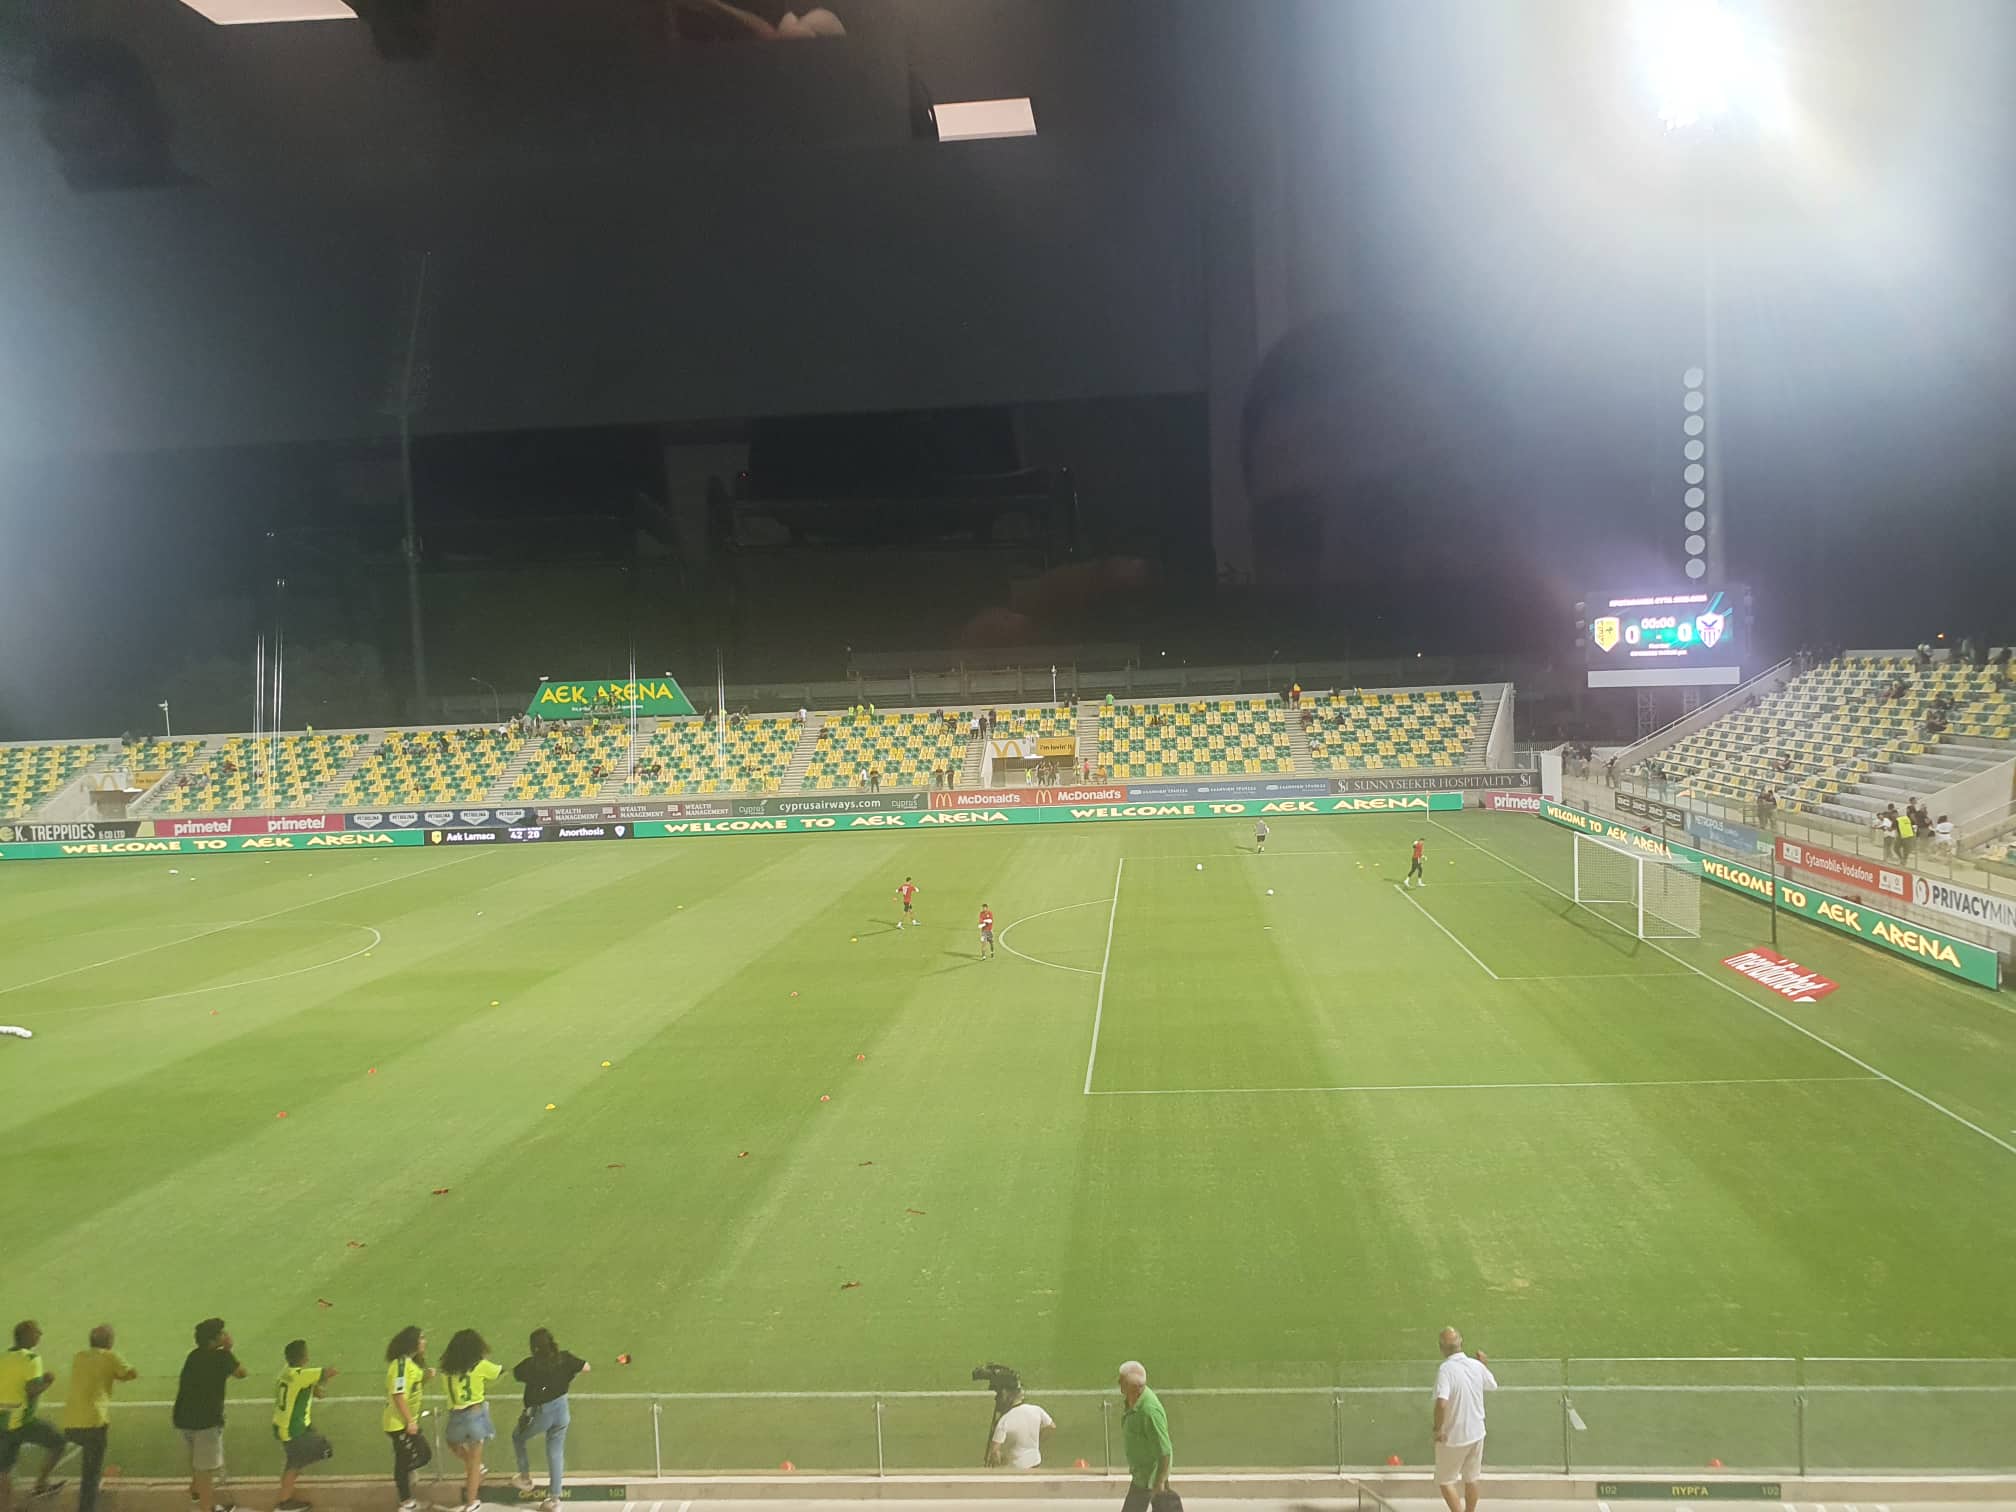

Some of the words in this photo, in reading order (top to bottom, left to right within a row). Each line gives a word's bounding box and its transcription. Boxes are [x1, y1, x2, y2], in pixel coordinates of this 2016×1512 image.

[1625, 626, 1640, 644] 0
[1677, 623, 1693, 642] 0
[541, 686, 588, 704] AEK
[594, 682, 673, 703] ARENA
[1354, 778, 1436, 791] SUNNYSEEKER
[1440, 776, 1514, 788] HOSPITALITY
[957, 794, 1020, 805] McDonald's
[1057, 790, 1121, 801] McDonald's
[620, 810, 664, 818] MANAGEMENT
[685, 803, 712, 811] WEALTH
[686, 808, 729, 816] MANAGEMENT
[779, 800, 881, 812] cyprusairways.com
[1070, 805, 1195, 819] WELCOME
[1209, 804, 1245, 814] TO
[1261, 801, 1319, 812] AEK
[1332, 797, 1429, 810] ARENA
[174, 819, 232, 836] primetel
[268, 816, 325, 833] primetel
[664, 820, 787, 833] WELCOME
[800, 818, 836, 828] TO
[850, 815, 905, 826] AEK
[918, 812, 1008, 824] ARENA
[15, 825, 28, 841] K.
[30, 824, 95, 840] TREPPIDES
[114, 830, 125, 839] LTD
[447, 832, 465, 841] Aek
[559, 827, 604, 837] Anorthosis
[1546, 806, 1587, 828] WELCOME
[1589, 819, 1603, 833] TO
[1606, 827, 1628, 845] AEK
[1632, 835, 1673, 859] ARENA
[62, 841, 181, 854] WELCOME
[193, 839, 227, 849] TO
[242, 837, 294, 848] AEK
[307, 834, 394, 846] ARENA
[1805, 852, 1873, 884] Cytamobile-Vodafone
[1702, 858, 1774, 896] WELCOME
[1782, 886, 1807, 908] TO
[1817, 901, 1862, 932] AEK
[1871, 921, 1961, 969] ARENA
[1672, 1485, 1709, 1497] ΠΥΡΓΑ
